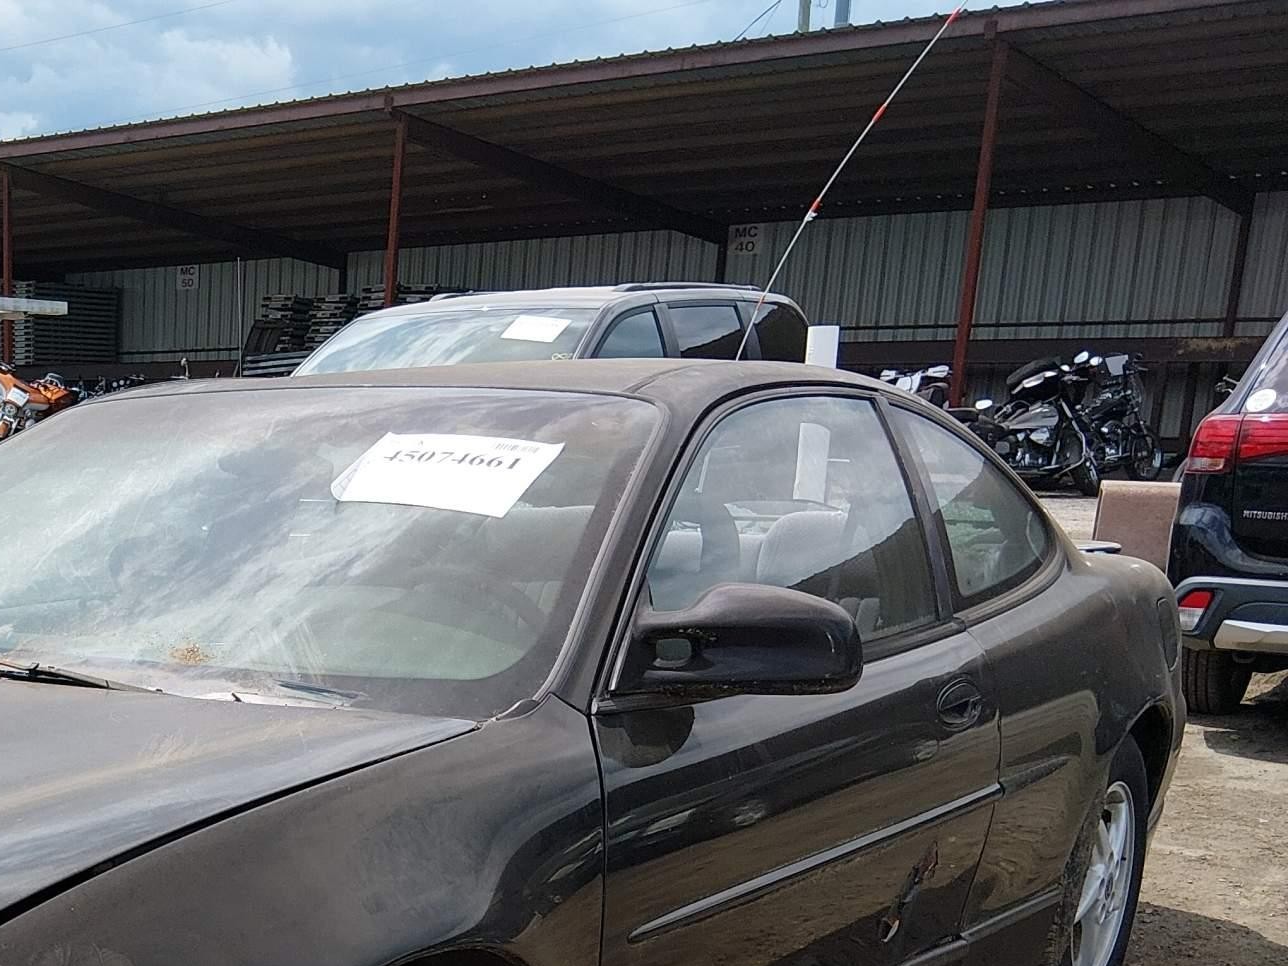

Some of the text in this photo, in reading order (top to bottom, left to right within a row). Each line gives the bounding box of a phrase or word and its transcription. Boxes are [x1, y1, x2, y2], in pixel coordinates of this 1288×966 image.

[735, 226, 758, 238] MC
[734, 241, 755, 252] 40
[180, 266, 195, 276] MC
[383, 450, 521, 470] 45074661
[1243, 510, 1288, 520] MITSUBISH
